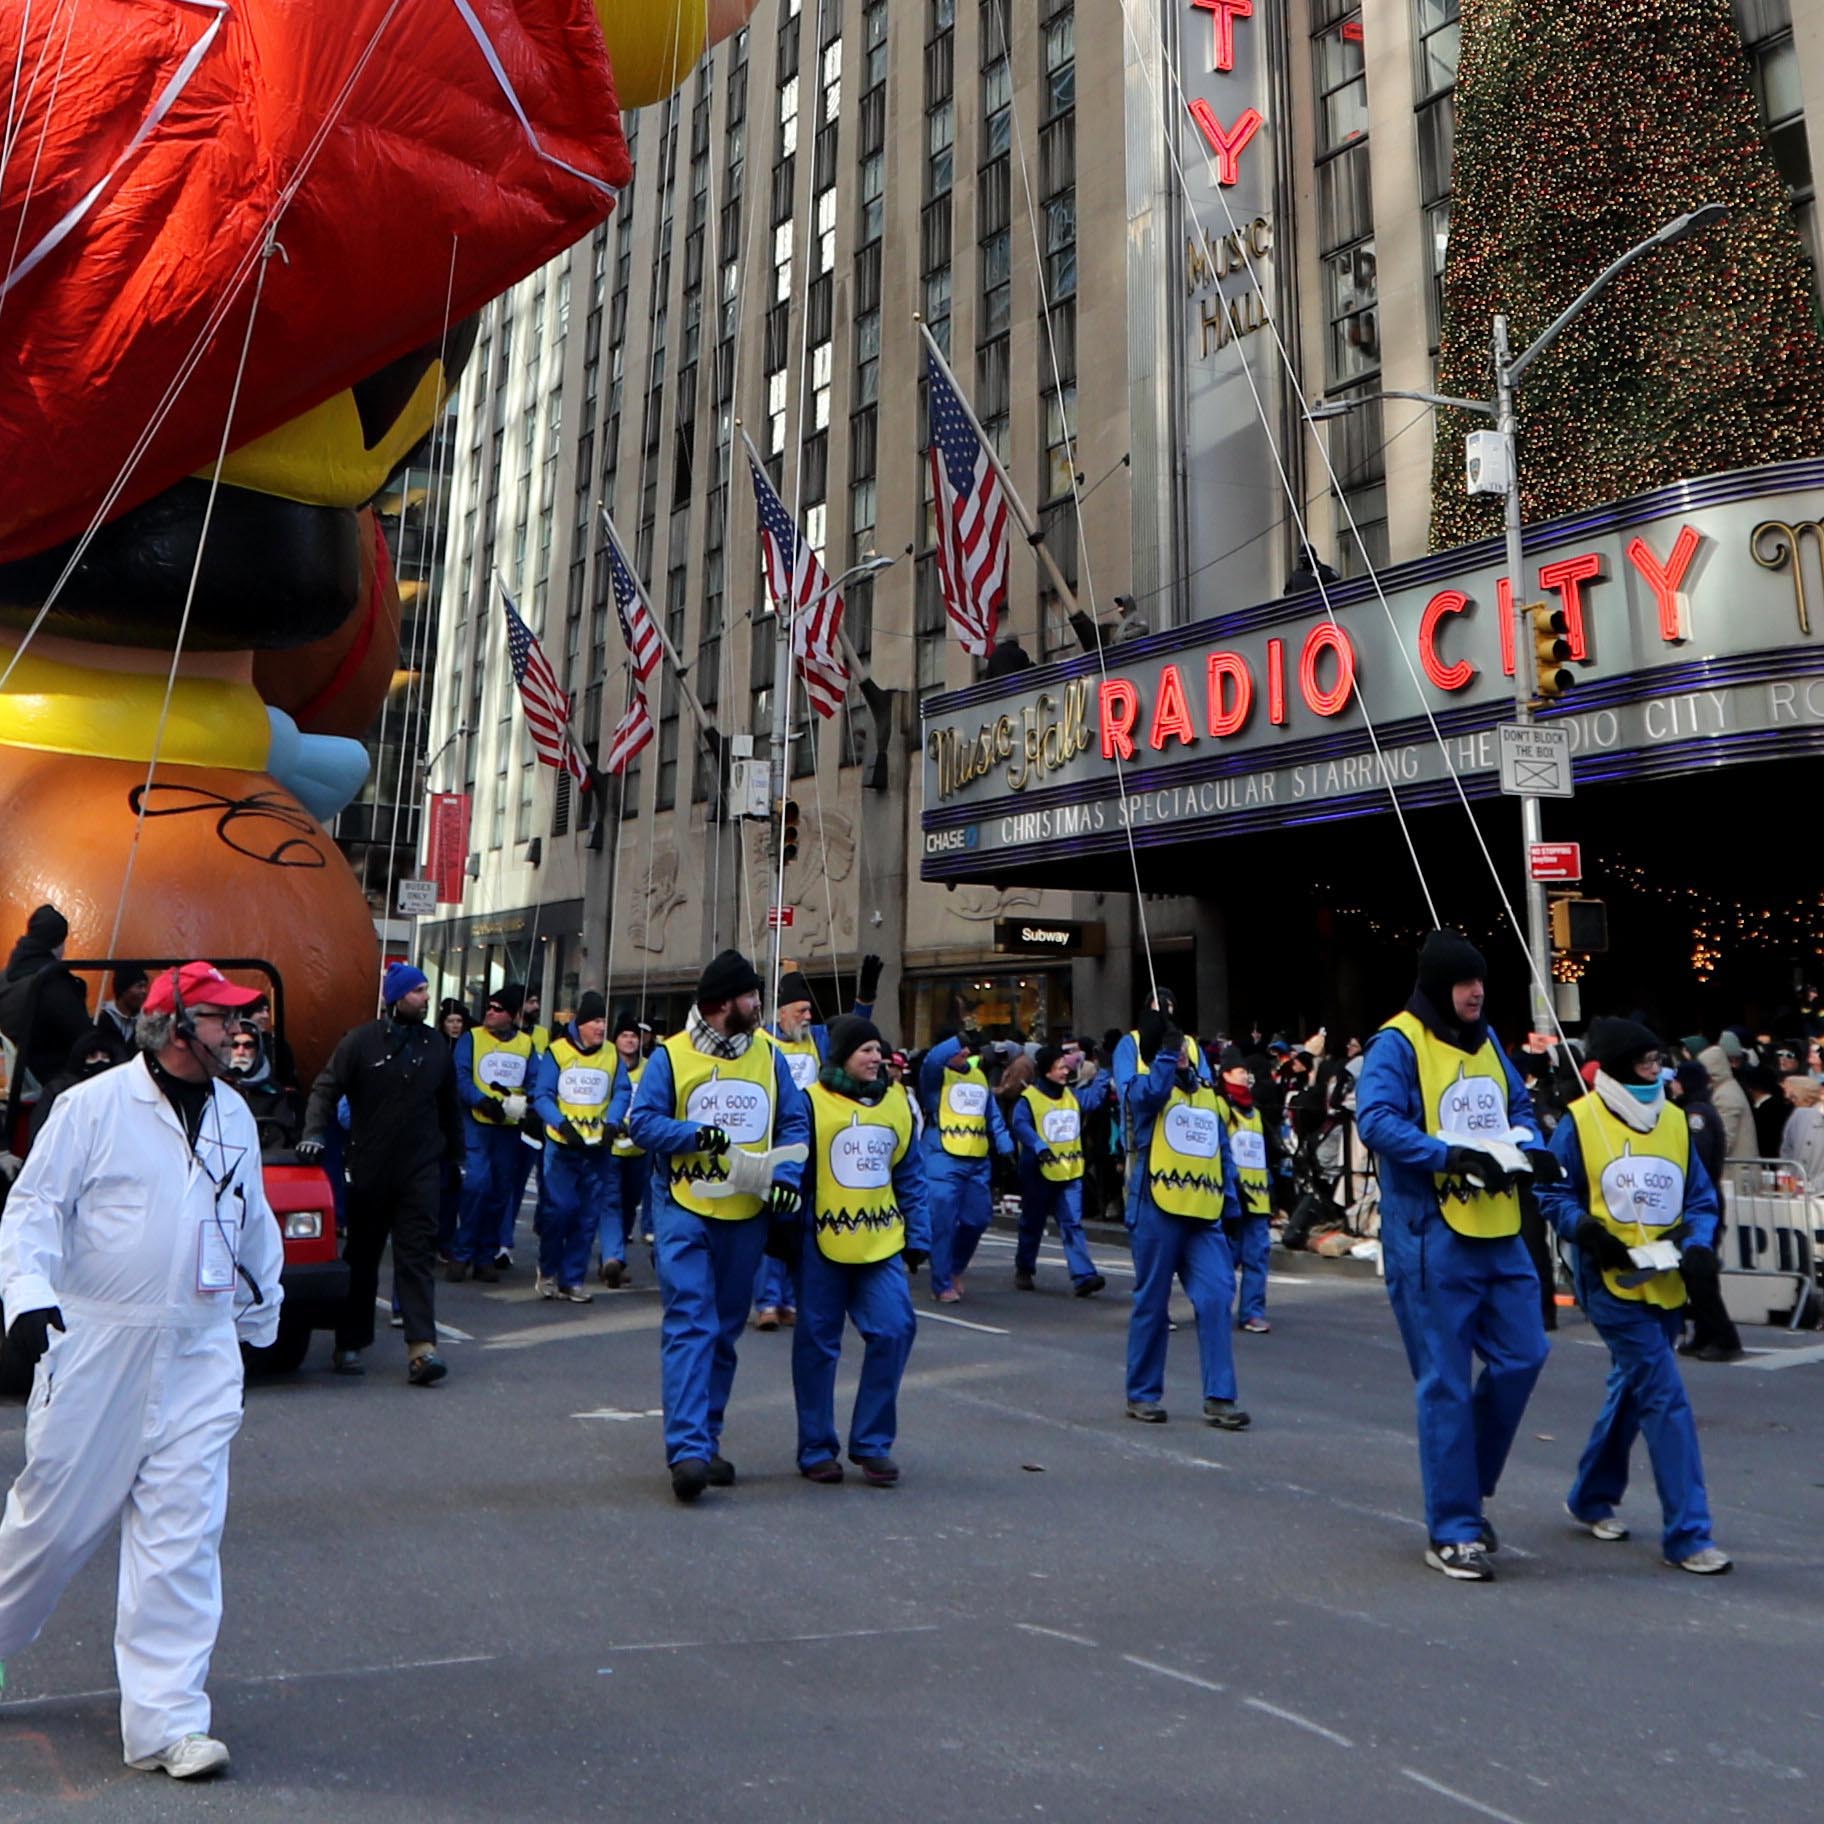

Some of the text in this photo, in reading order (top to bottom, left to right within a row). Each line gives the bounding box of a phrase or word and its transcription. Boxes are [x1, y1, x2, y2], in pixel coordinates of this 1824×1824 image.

[1187, 218, 1269, 297] MUSIC
[1200, 286, 1275, 360] HALL
[1098, 525, 1701, 760] RADIO CITY
[929, 675, 1094, 801] Music Hall
[1504, 729, 1564, 744] DON'T BLOCK
[1516, 745, 1555, 758] THE BOX
[1002, 805, 1104, 844] CHRISTMAS
[1119, 772, 1274, 826] SPECTACULAR
[1294, 745, 1418, 798] STARRING
[1443, 732, 1494, 773] THE
[1646, 690, 1728, 739] CITY
[926, 830, 965, 852] CHASE
[1022, 928, 1069, 945] Subway
[726, 1095, 758, 1109] GOOD
[1644, 1173, 1673, 1190] GOOD
